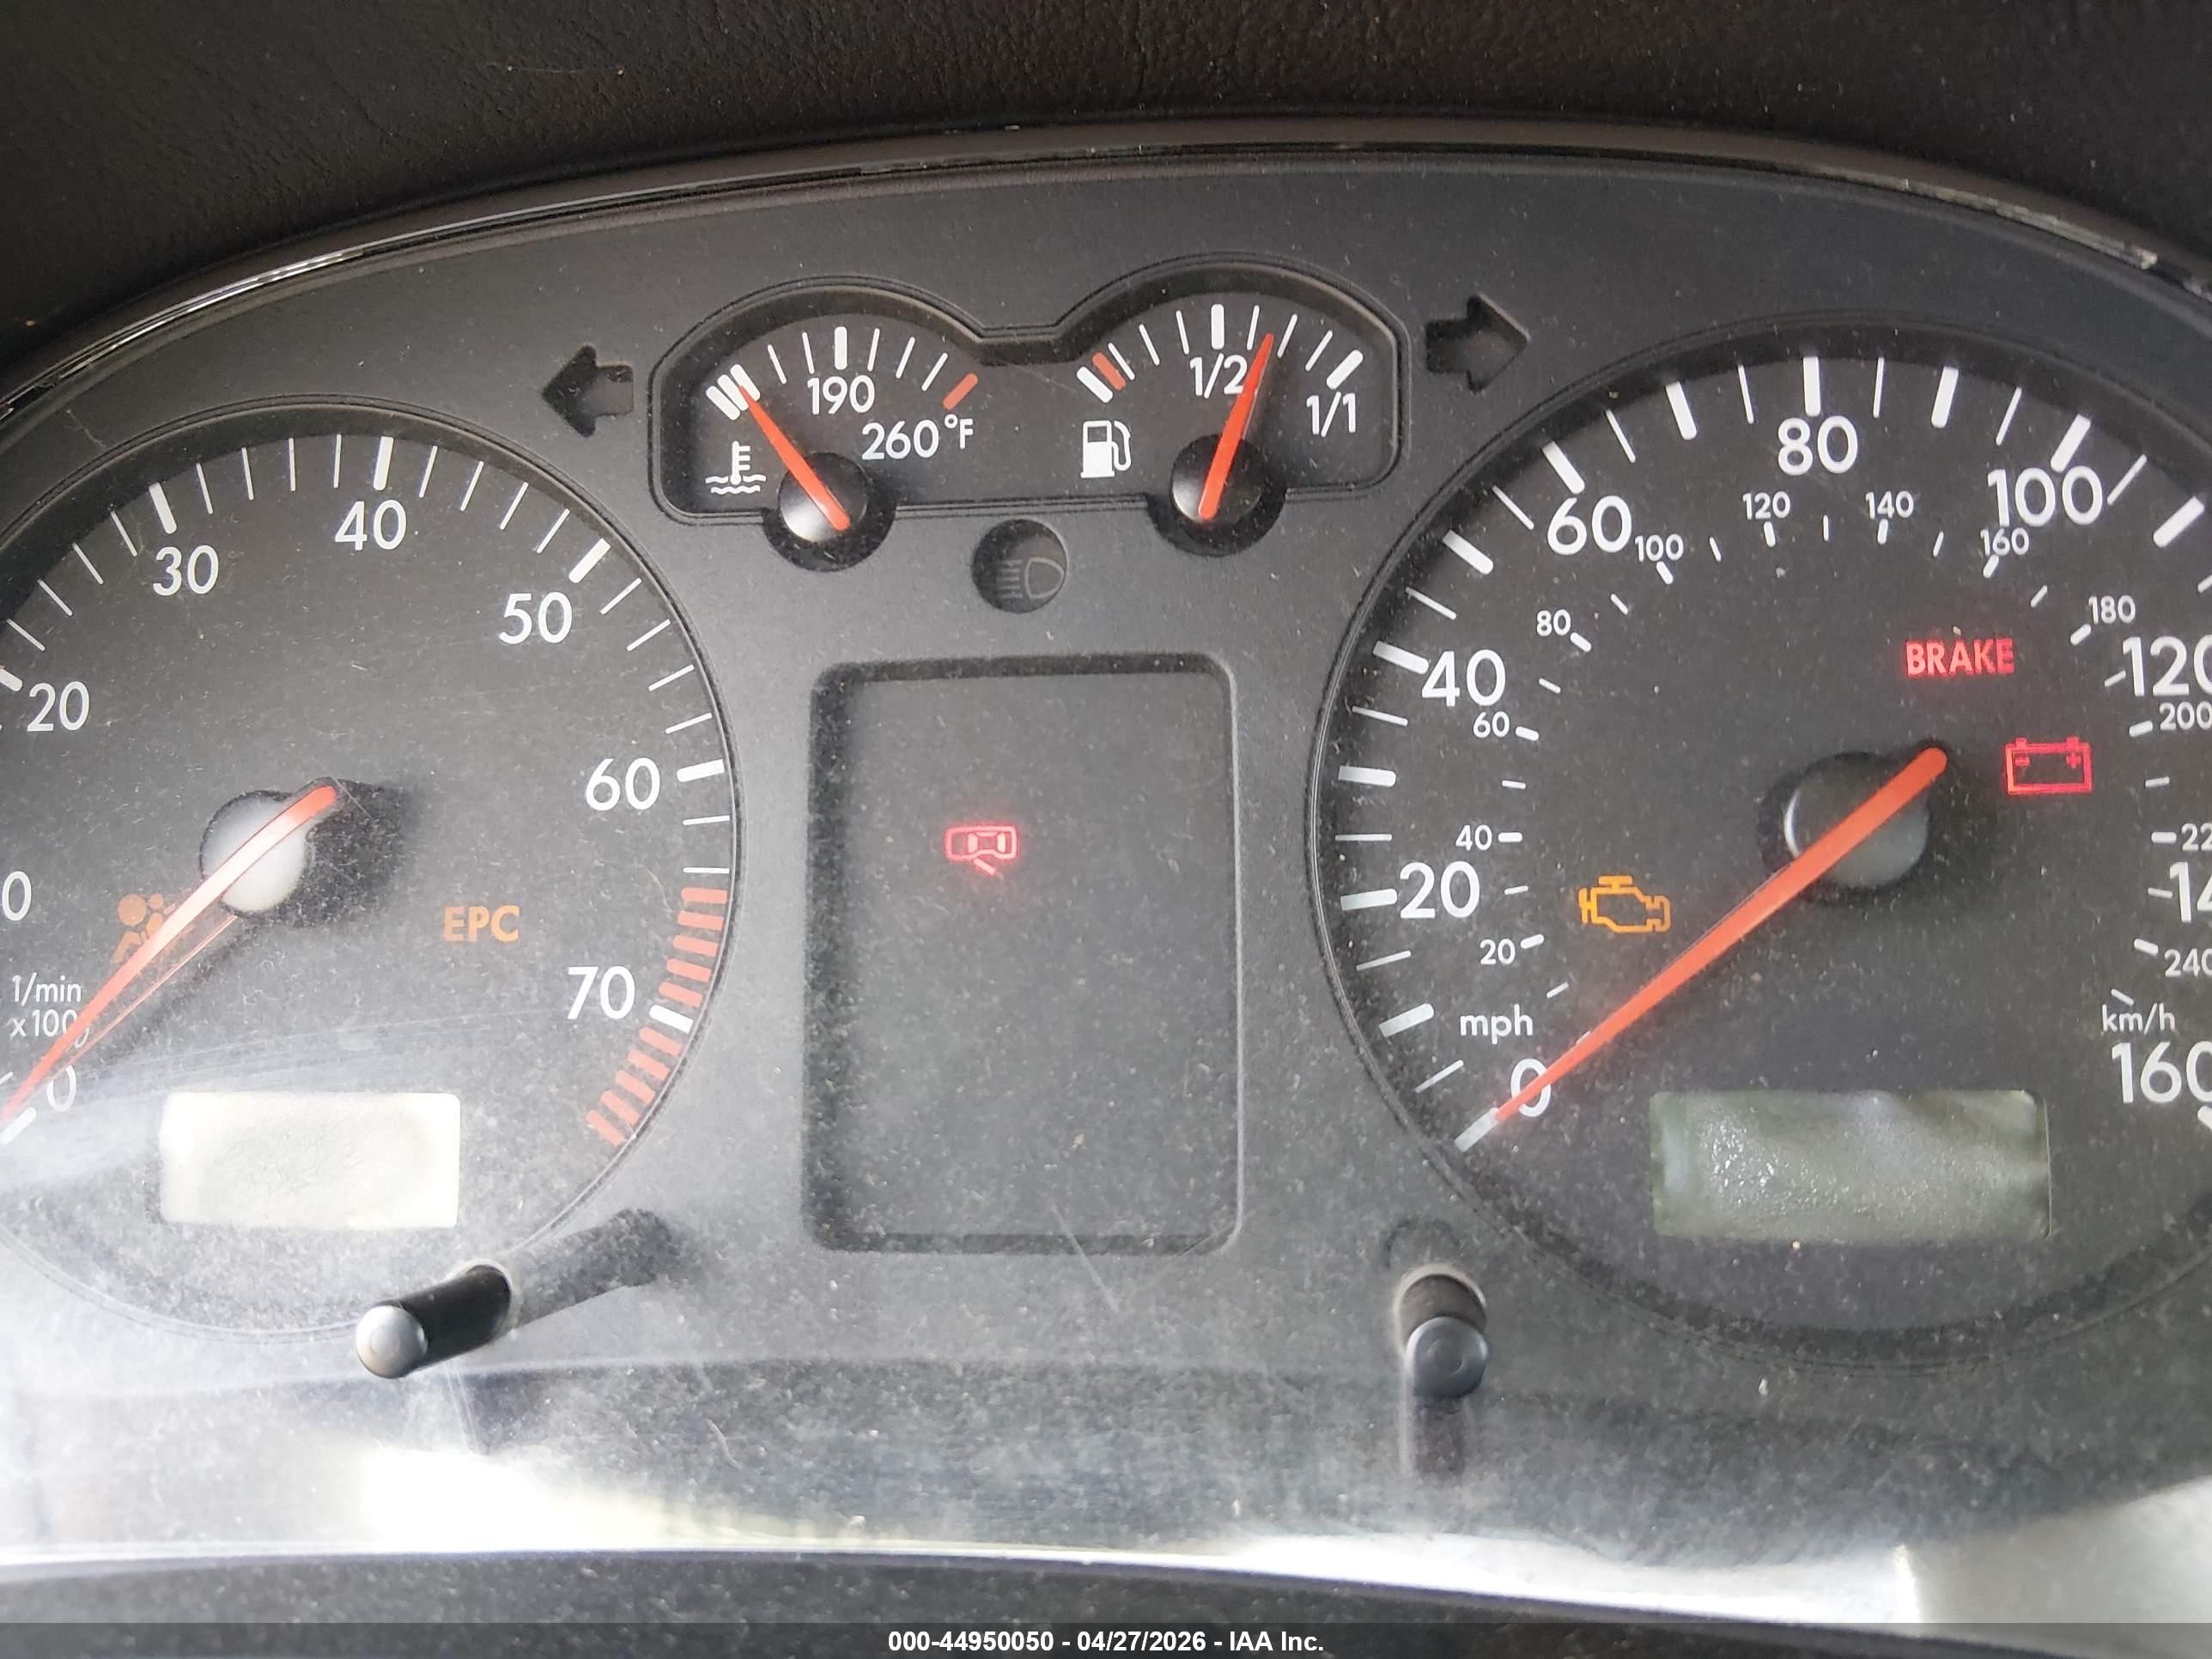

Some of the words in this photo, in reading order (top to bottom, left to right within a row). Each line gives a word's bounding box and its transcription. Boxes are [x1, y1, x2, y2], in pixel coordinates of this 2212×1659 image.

[807, 374, 875, 415] 190
[1189, 353, 1248, 398] 1/2
[1306, 391, 1357, 437] 1/1
[1777, 416, 1858, 476] 80
[1743, 491, 1790, 520] 120
[1866, 491, 1914, 519] 140
[1987, 465, 2102, 526] 100
[335, 499, 407, 551] 40
[1547, 495, 1632, 555] 60
[1981, 528, 2029, 556] 160
[1635, 534, 1684, 562] 100
[152, 545, 219, 596] 30
[499, 591, 573, 645] 50
[1536, 609, 1571, 637] 80
[2088, 595, 2136, 624] 180
[1422, 649, 1506, 708] 40
[1905, 638, 2014, 677] BRAKE
[27, 682, 90, 732] 20
[1473, 711, 1510, 738] 60
[586, 757, 660, 811] 60
[1455, 824, 1492, 851] 40
[1399, 860, 1480, 919] 20
[443, 905, 520, 943] EPC
[1480, 939, 1516, 965] 20
[12, 972, 82, 1006] 1/min
[567, 966, 635, 1020] 70
[1460, 1004, 1533, 1044] mph
[2101, 1002, 2176, 1035] km/h
[1510, 1058, 1552, 1118] 0
[2112, 1041, 2212, 1104] 160
